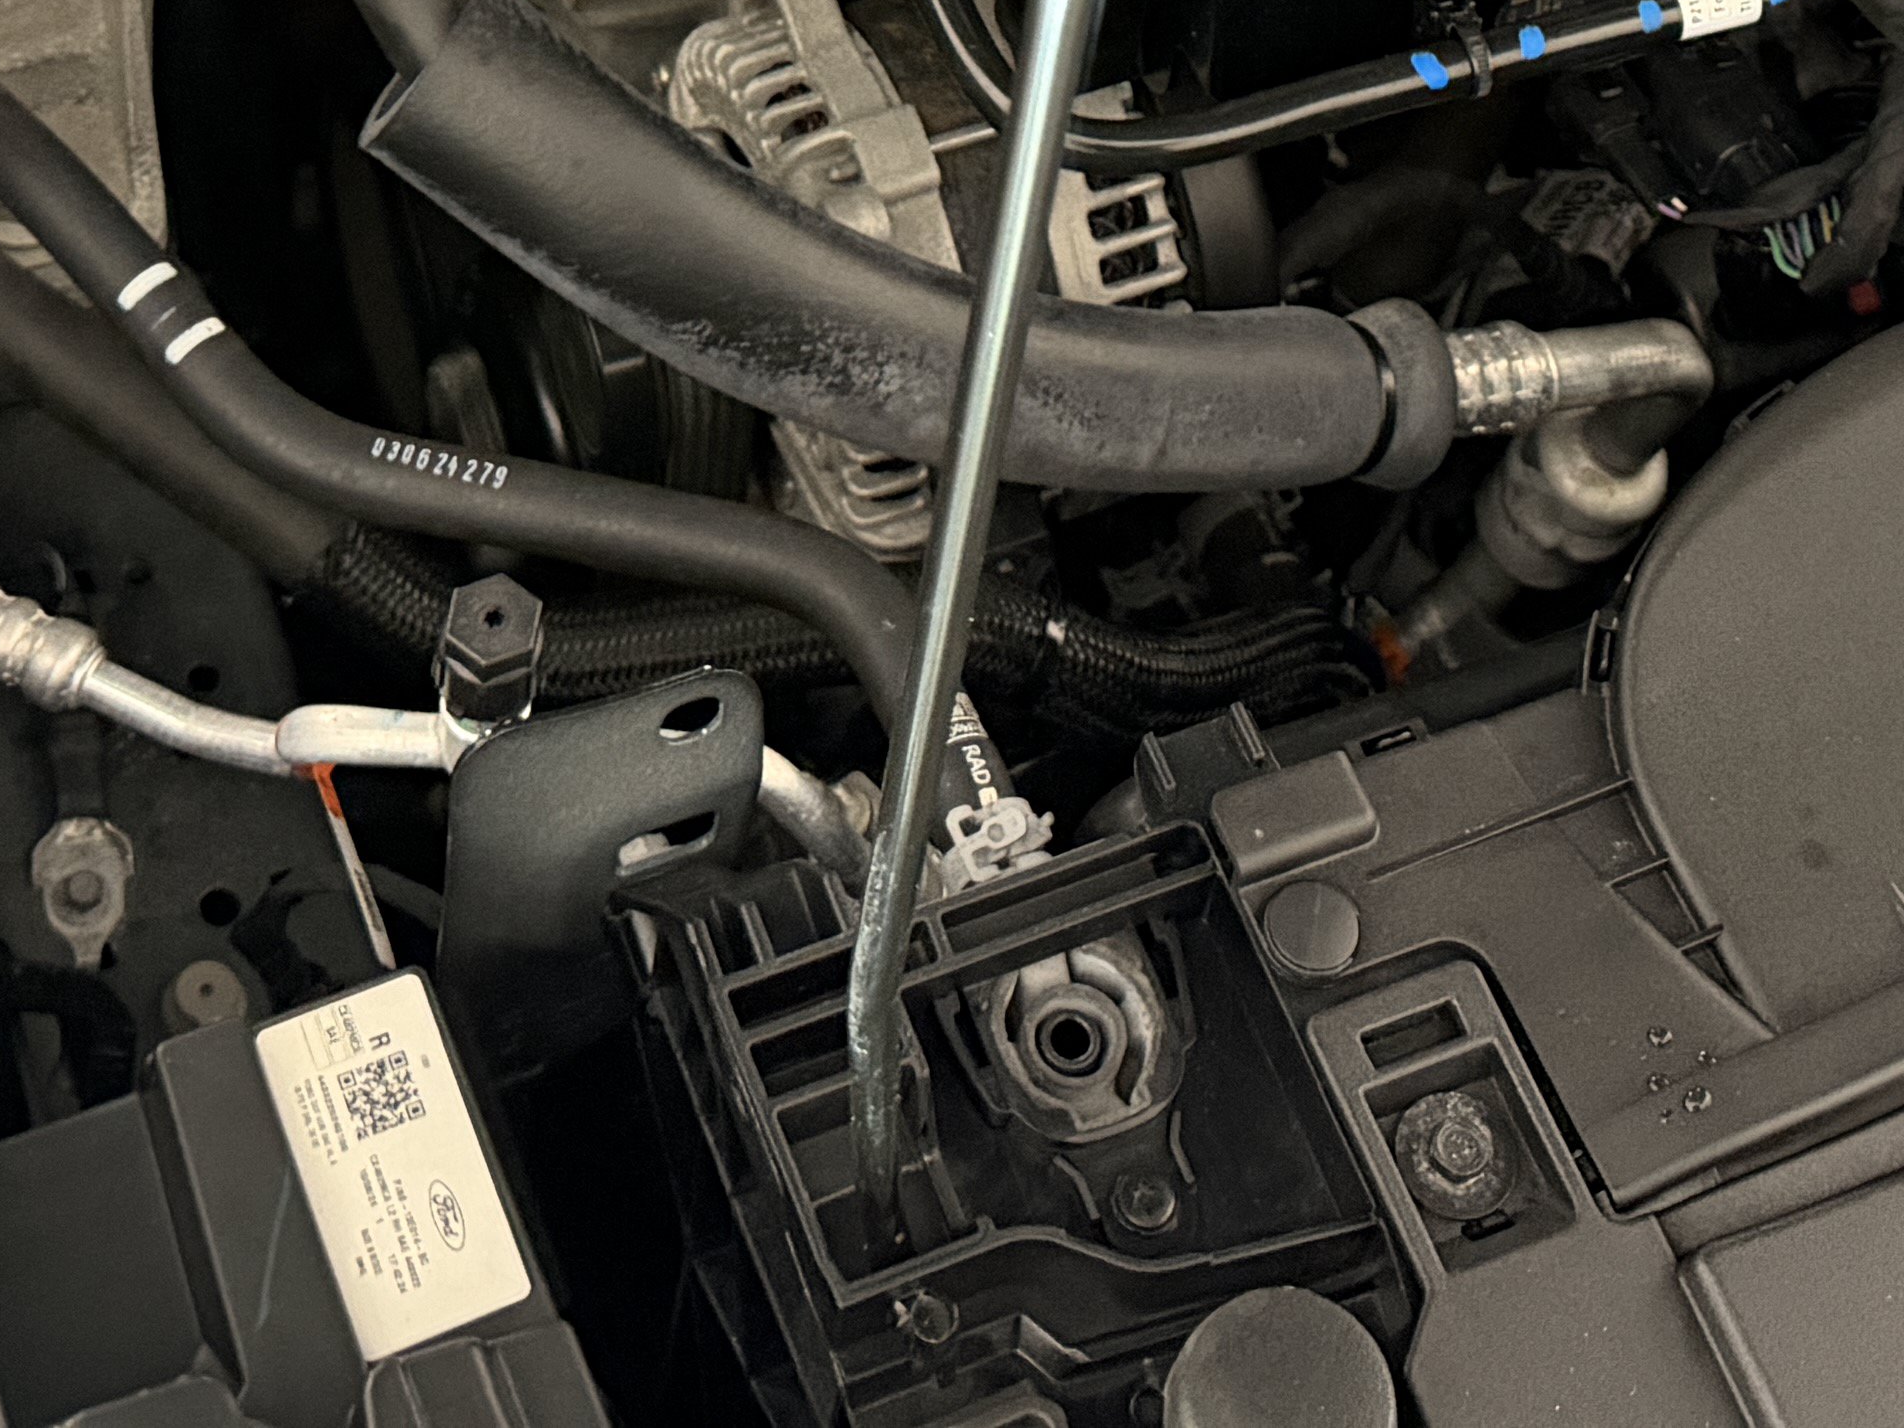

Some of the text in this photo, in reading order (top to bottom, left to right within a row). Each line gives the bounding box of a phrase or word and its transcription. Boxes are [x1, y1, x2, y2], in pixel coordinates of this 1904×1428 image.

[961, 743, 991, 786] RAD
[368, 1031, 392, 1050] R
[431, 1192, 461, 1239] Ford
